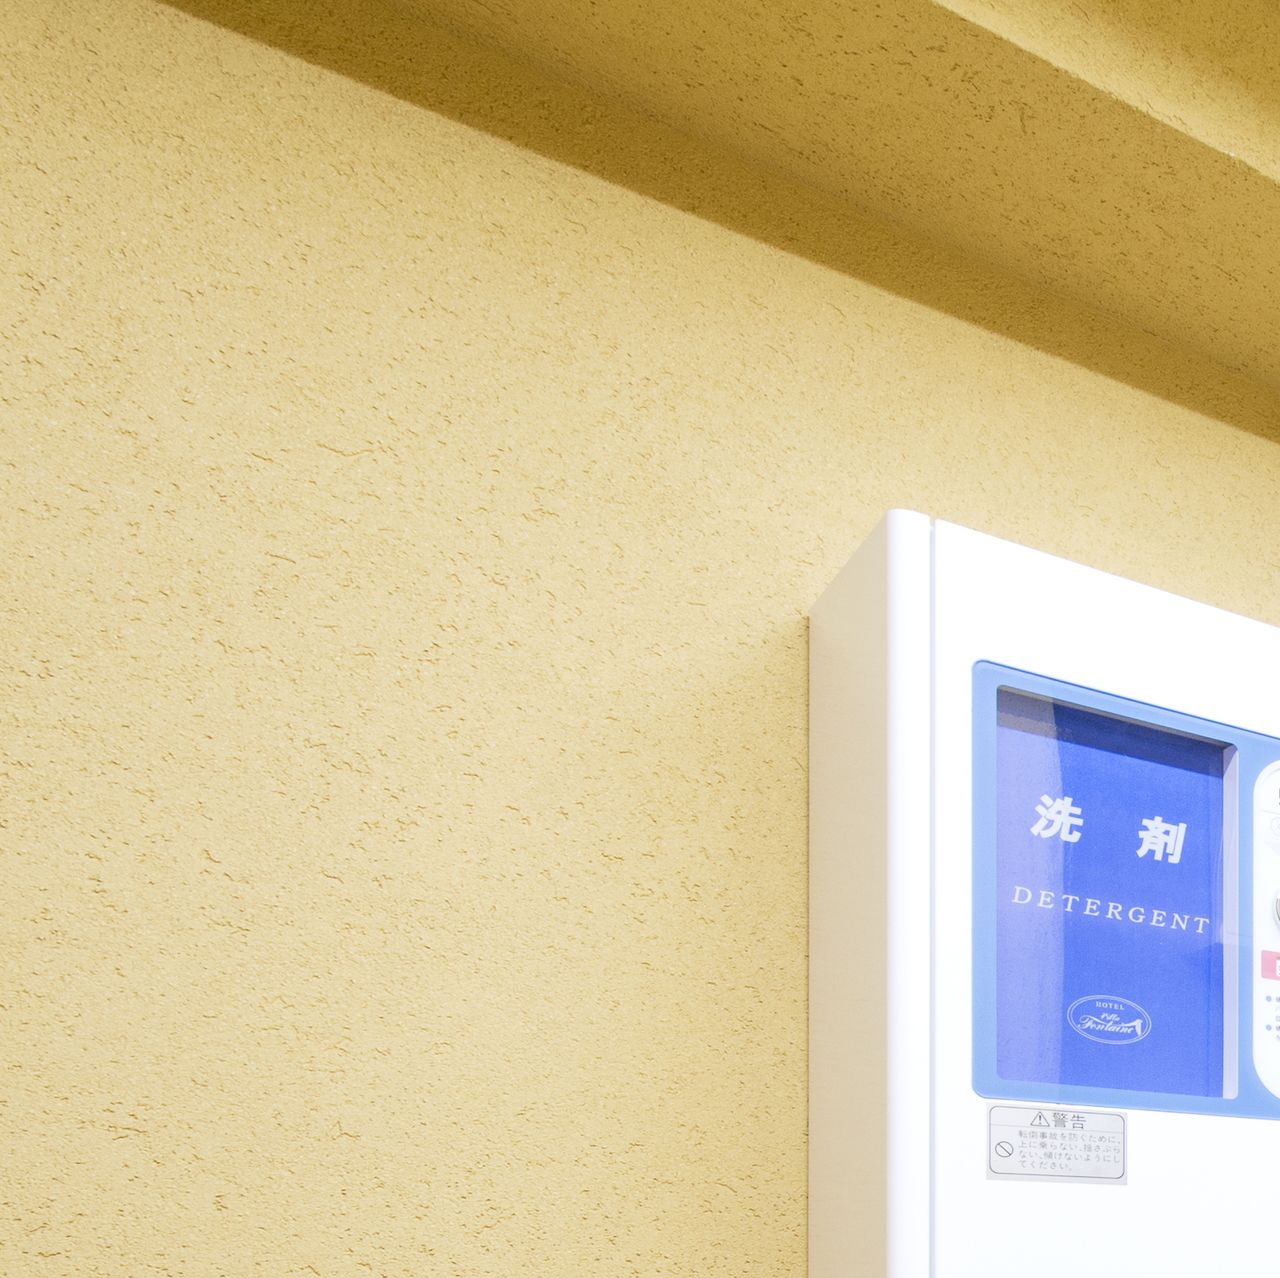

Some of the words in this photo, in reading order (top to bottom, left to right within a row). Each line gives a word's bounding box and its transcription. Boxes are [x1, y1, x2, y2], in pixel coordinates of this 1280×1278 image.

[1012, 885, 1210, 934] DETERGENT
[1095, 1001, 1125, 1010] HOTEL
[1052, 1112, 1087, 1129] 警告
